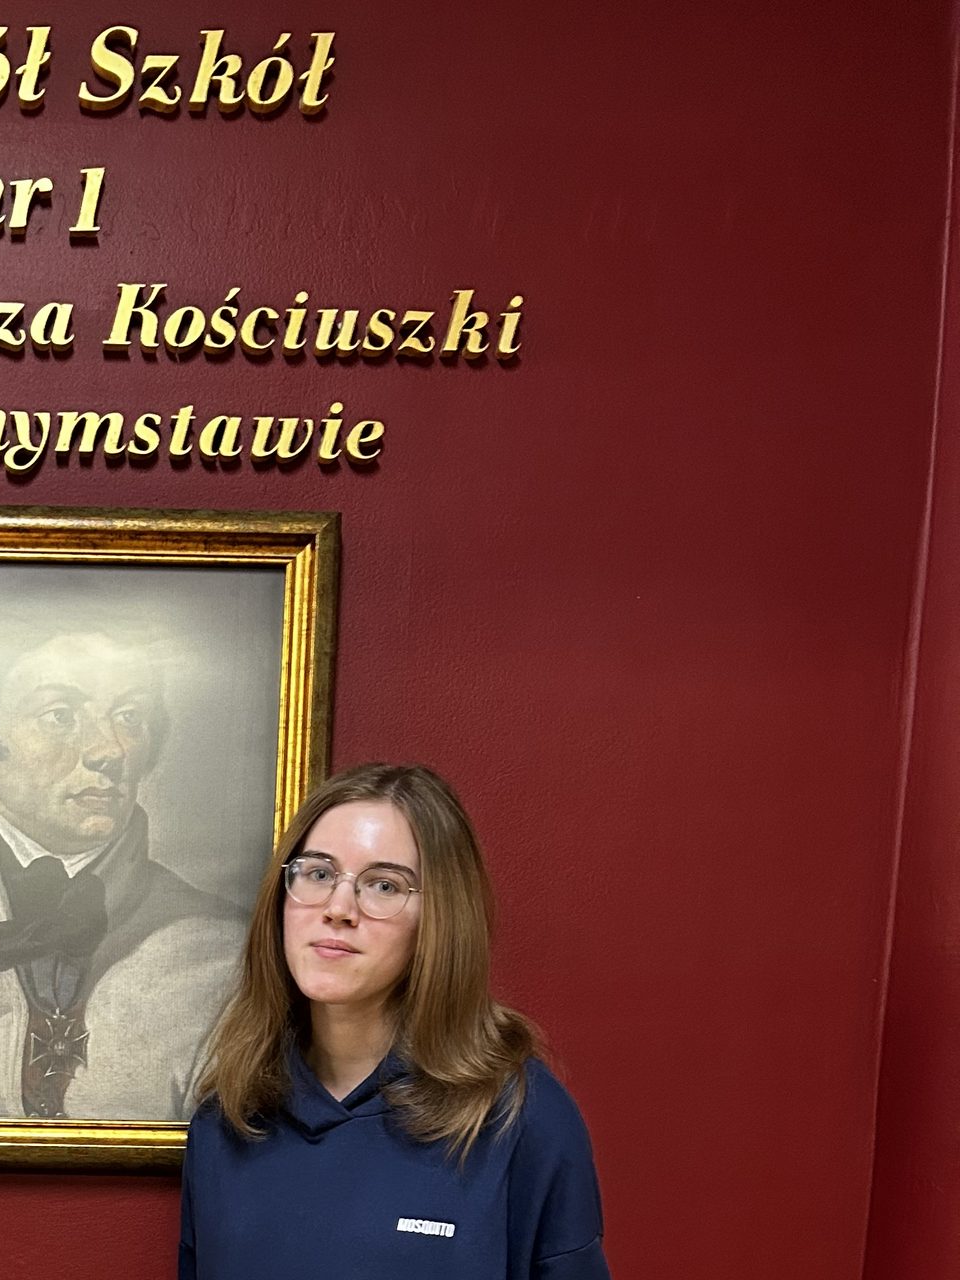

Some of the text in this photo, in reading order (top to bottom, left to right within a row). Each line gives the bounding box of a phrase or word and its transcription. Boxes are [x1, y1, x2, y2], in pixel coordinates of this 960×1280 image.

[77, 25, 337, 108] Szkół
[67, 166, 107, 235] 1
[101, 282, 525, 356] Kościuszki
